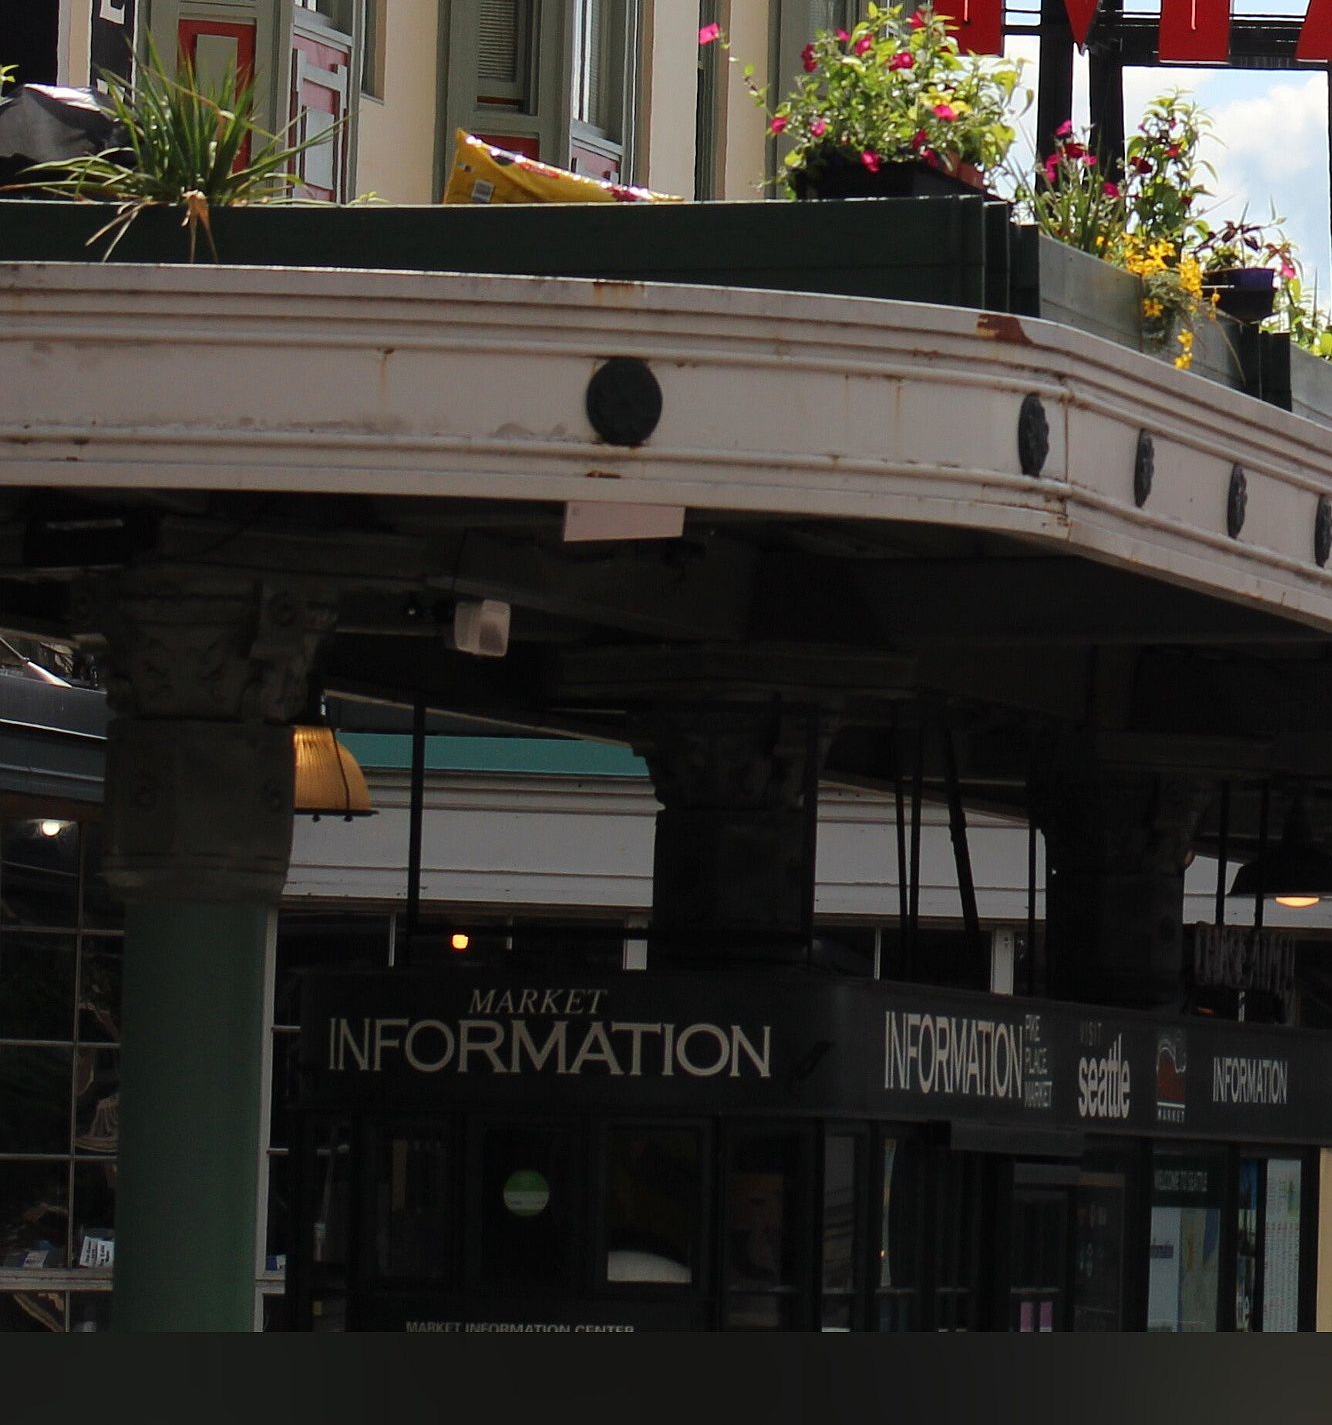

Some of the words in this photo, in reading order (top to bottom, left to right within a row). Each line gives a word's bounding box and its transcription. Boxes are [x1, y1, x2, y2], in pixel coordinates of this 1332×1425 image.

[468, 989, 608, 1014] MARKET
[329, 1018, 771, 1077] INFORMATION
[884, 1011, 1022, 1098] INFORMATION
[1078, 1033, 1131, 1119] seattle
[1213, 1057, 1288, 1105] INFORMATION
